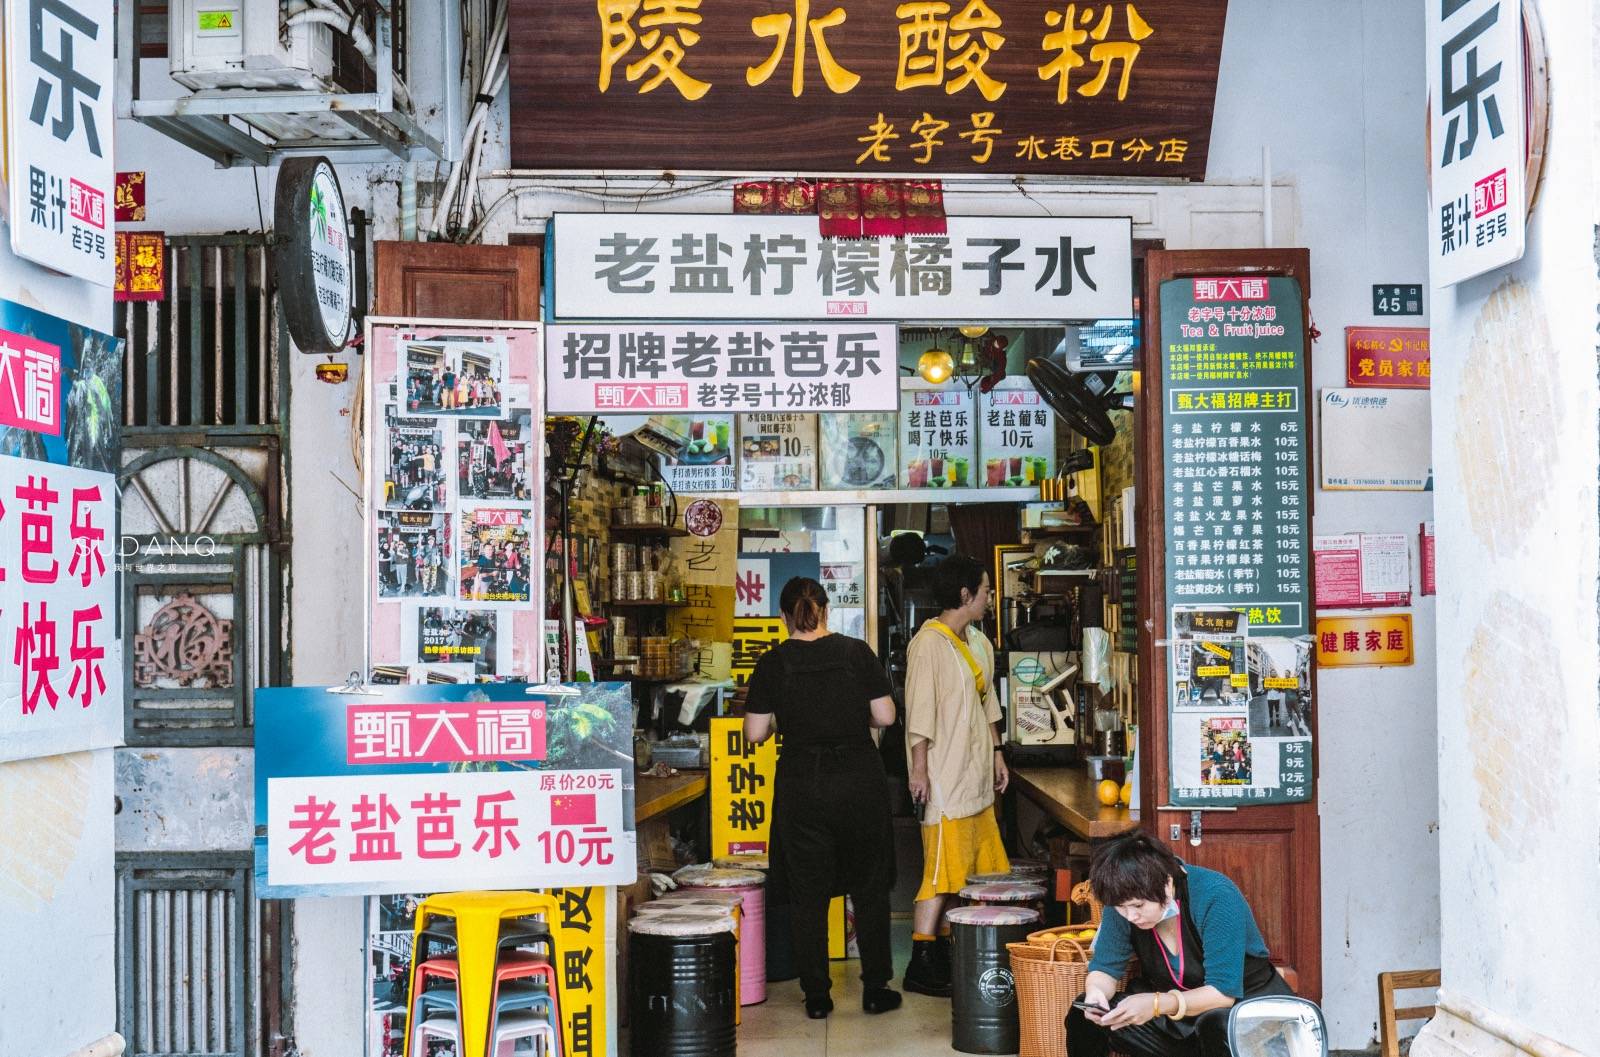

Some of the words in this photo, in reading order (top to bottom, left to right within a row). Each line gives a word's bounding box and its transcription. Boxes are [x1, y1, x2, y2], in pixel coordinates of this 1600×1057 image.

[600, 0, 1153, 104] 陵水酸粉
[1442, 0, 1505, 168] 乐
[856, 112, 1003, 164] 老字号
[1015, 136, 1188, 163] 水巷口分店
[29, 164, 67, 235] 果汁
[70, 182, 104, 226] 甄大福
[1441, 193, 1471, 256] 果汁
[1476, 213, 1507, 248] 老字号
[72, 225, 105, 260] 老字号
[594, 232, 1098, 298] 老盐柠檬橘子水
[1196, 279, 1264, 299] 甄大福
[827, 301, 867, 315] 甄大福
[1188, 306, 1276, 322] 老字号十分浓郁
[1379, 298, 1401, 312] 45
[1181, 324, 1203, 337] Tea
[1208, 324, 1219, 337] &
[1224, 324, 1253, 337] Fruit
[1254, 324, 1284, 339] juice
[563, 332, 882, 380] 招牌老盐芭乐
[1358, 358, 1430, 377] 党员家庭
[597, 386, 682, 406] 甄大福
[698, 382, 851, 408] 老字号十分浓郁
[1177, 391, 1292, 410] 甄大福招牌主打
[907, 410, 968, 428] 老盐芭乐
[987, 410, 1048, 427] 老盐葡萄
[1172, 422, 1261, 434] 老盐柠檬水
[1280, 421, 1298, 432] 6元
[908, 429, 968, 446] 喝了快乐
[1001, 430, 1034, 448] 10元
[1274, 437, 1298, 447] 10元
[783, 436, 811, 458] 10元
[929, 449, 948, 460] 10元
[1275, 451, 1298, 461] 10元
[1275, 466, 1299, 476] 10元
[1173, 481, 1262, 492] 老盐芒果水
[1275, 481, 1299, 491] 15元
[1281, 495, 1299, 505] 8元
[1173, 510, 1263, 521] 老盐火龙果水
[1276, 510, 1300, 520] 15元
[0, 475, 106, 588] 芭乐
[1276, 525, 1300, 534] 18元
[1276, 539, 1300, 549] 10元
[1276, 554, 1300, 564] 10元
[1276, 569, 1300, 579] 10元
[1276, 583, 1300, 593] 15元
[837, 594, 860, 604] 10元
[1320, 629, 1404, 653] 健康家庭
[0, 601, 106, 715] 快乐
[354, 709, 532, 759] 甄大福
[1286, 743, 1304, 753] 9元
[1286, 758, 1304, 768] 9元
[540, 773, 615, 791] 原价20元
[1280, 773, 1304, 783] 12元
[1286, 787, 1304, 797] 9元
[288, 790, 521, 865] 老盐芭乐
[538, 826, 615, 867] 10元
